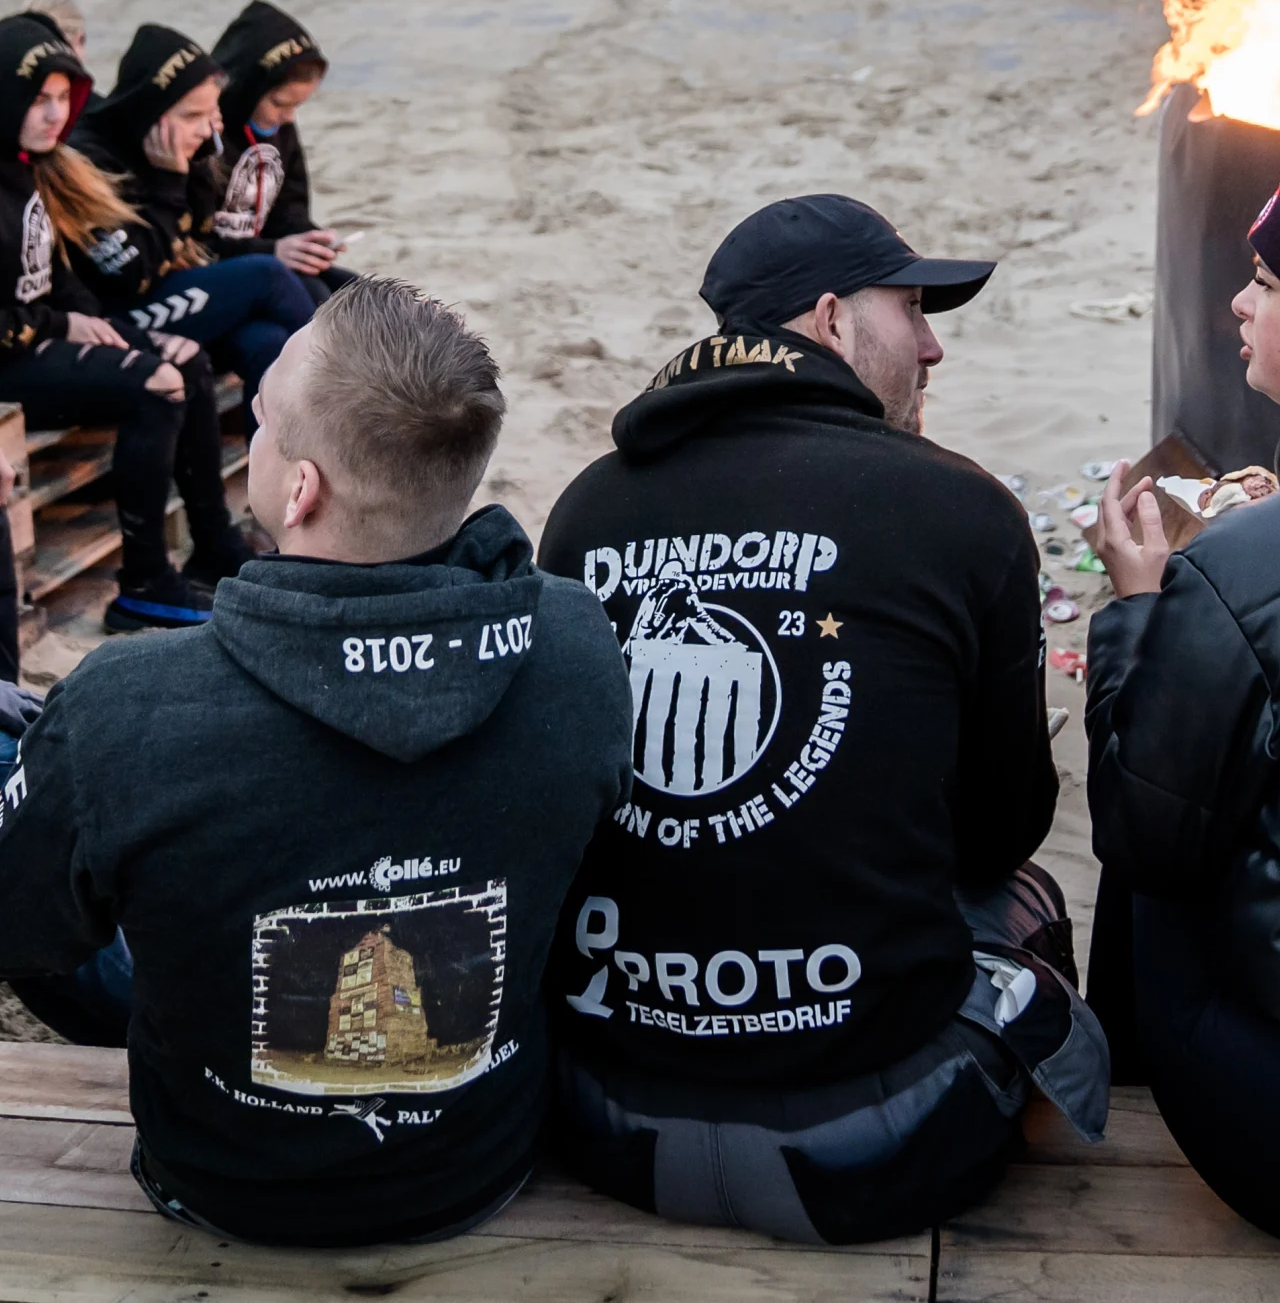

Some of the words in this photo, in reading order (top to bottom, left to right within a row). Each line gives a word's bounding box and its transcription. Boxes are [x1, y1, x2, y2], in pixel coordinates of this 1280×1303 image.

[710, 335, 804, 373] TAAK
[584, 530, 838, 603] DUINDORP
[478, 614, 533, 661] 2017
[777, 610, 806, 637] 23
[342, 633, 435, 673] 2018
[657, 818, 700, 849] OF
[708, 794, 775, 844] THE
[771, 660, 852, 809] LEGENDS
[614, 943, 862, 1007] PROTO
[625, 999, 852, 1037] TEGELZETBEDRIJF
[233, 1089, 323, 1116] HOLLAND
